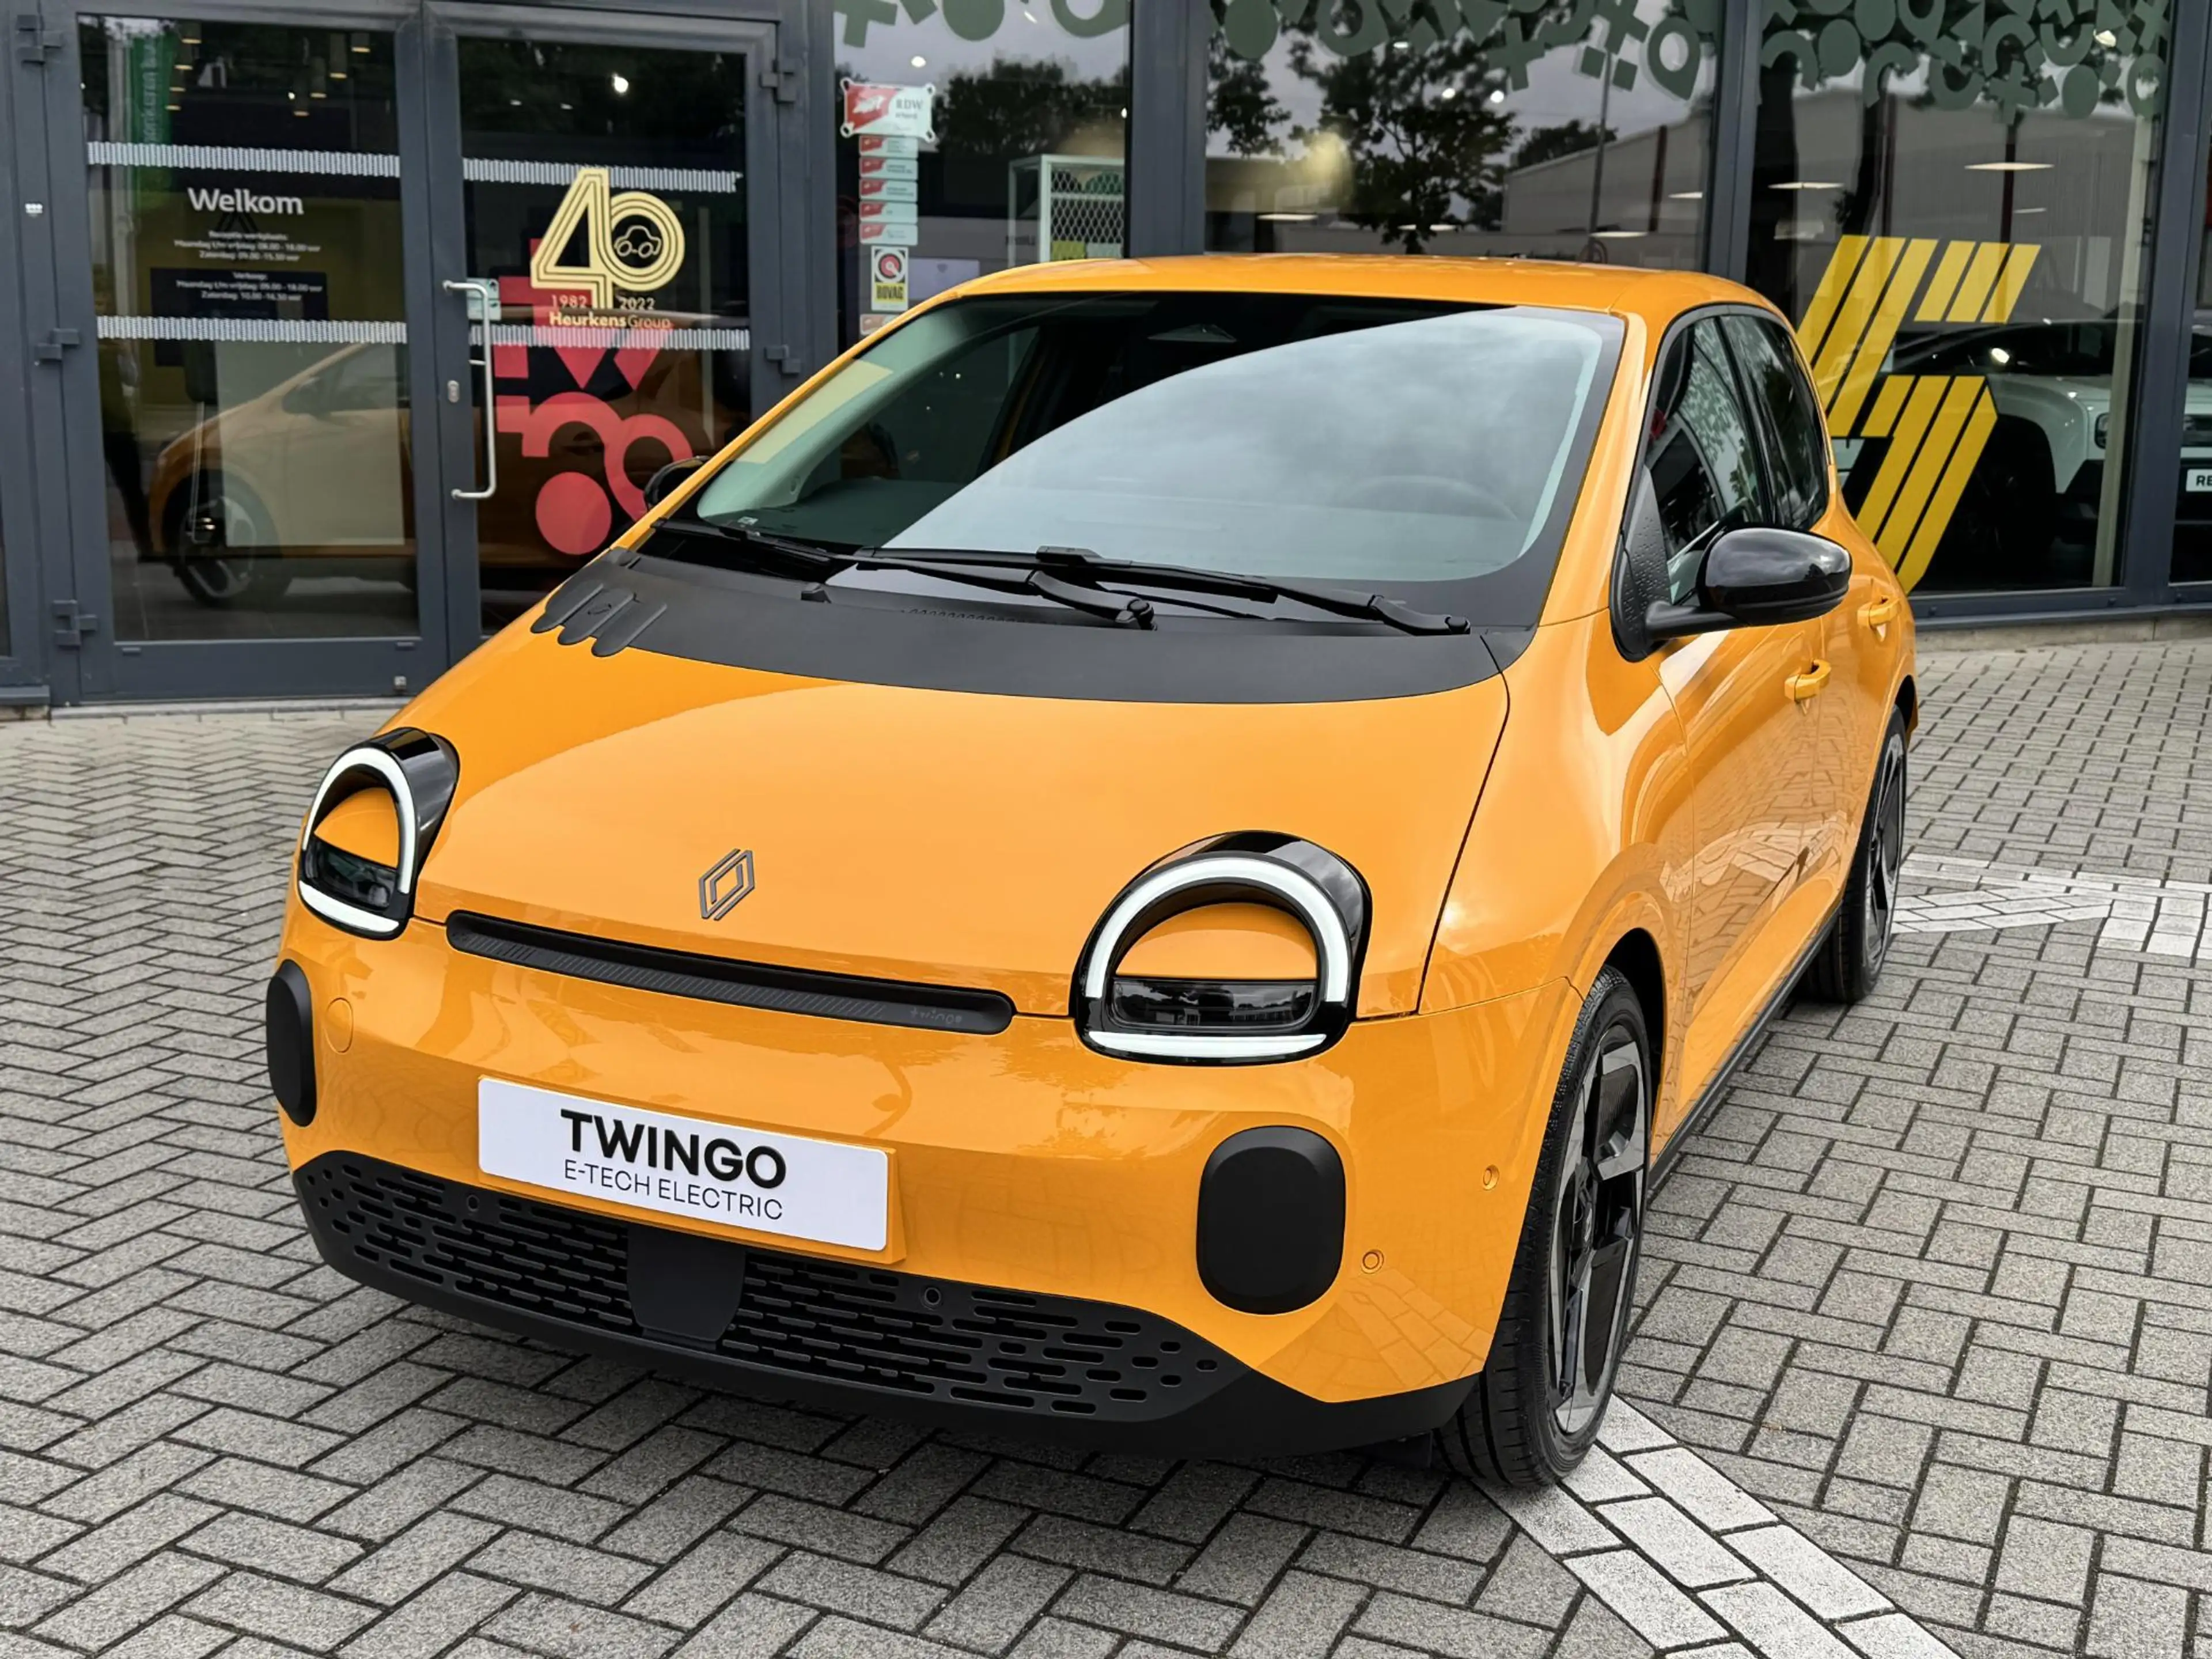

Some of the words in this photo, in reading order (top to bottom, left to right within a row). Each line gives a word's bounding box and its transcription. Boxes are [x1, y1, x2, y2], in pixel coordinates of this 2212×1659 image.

[187, 187, 304, 215] Welkom
[530, 166, 685, 309] 40
[551, 294, 588, 308] 1982
[619, 296, 656, 310] 2022
[560, 1108, 787, 1189] TWINGO
[564, 1160, 650, 1196] E-TECH
[658, 1179, 783, 1221] ELECTRIC
